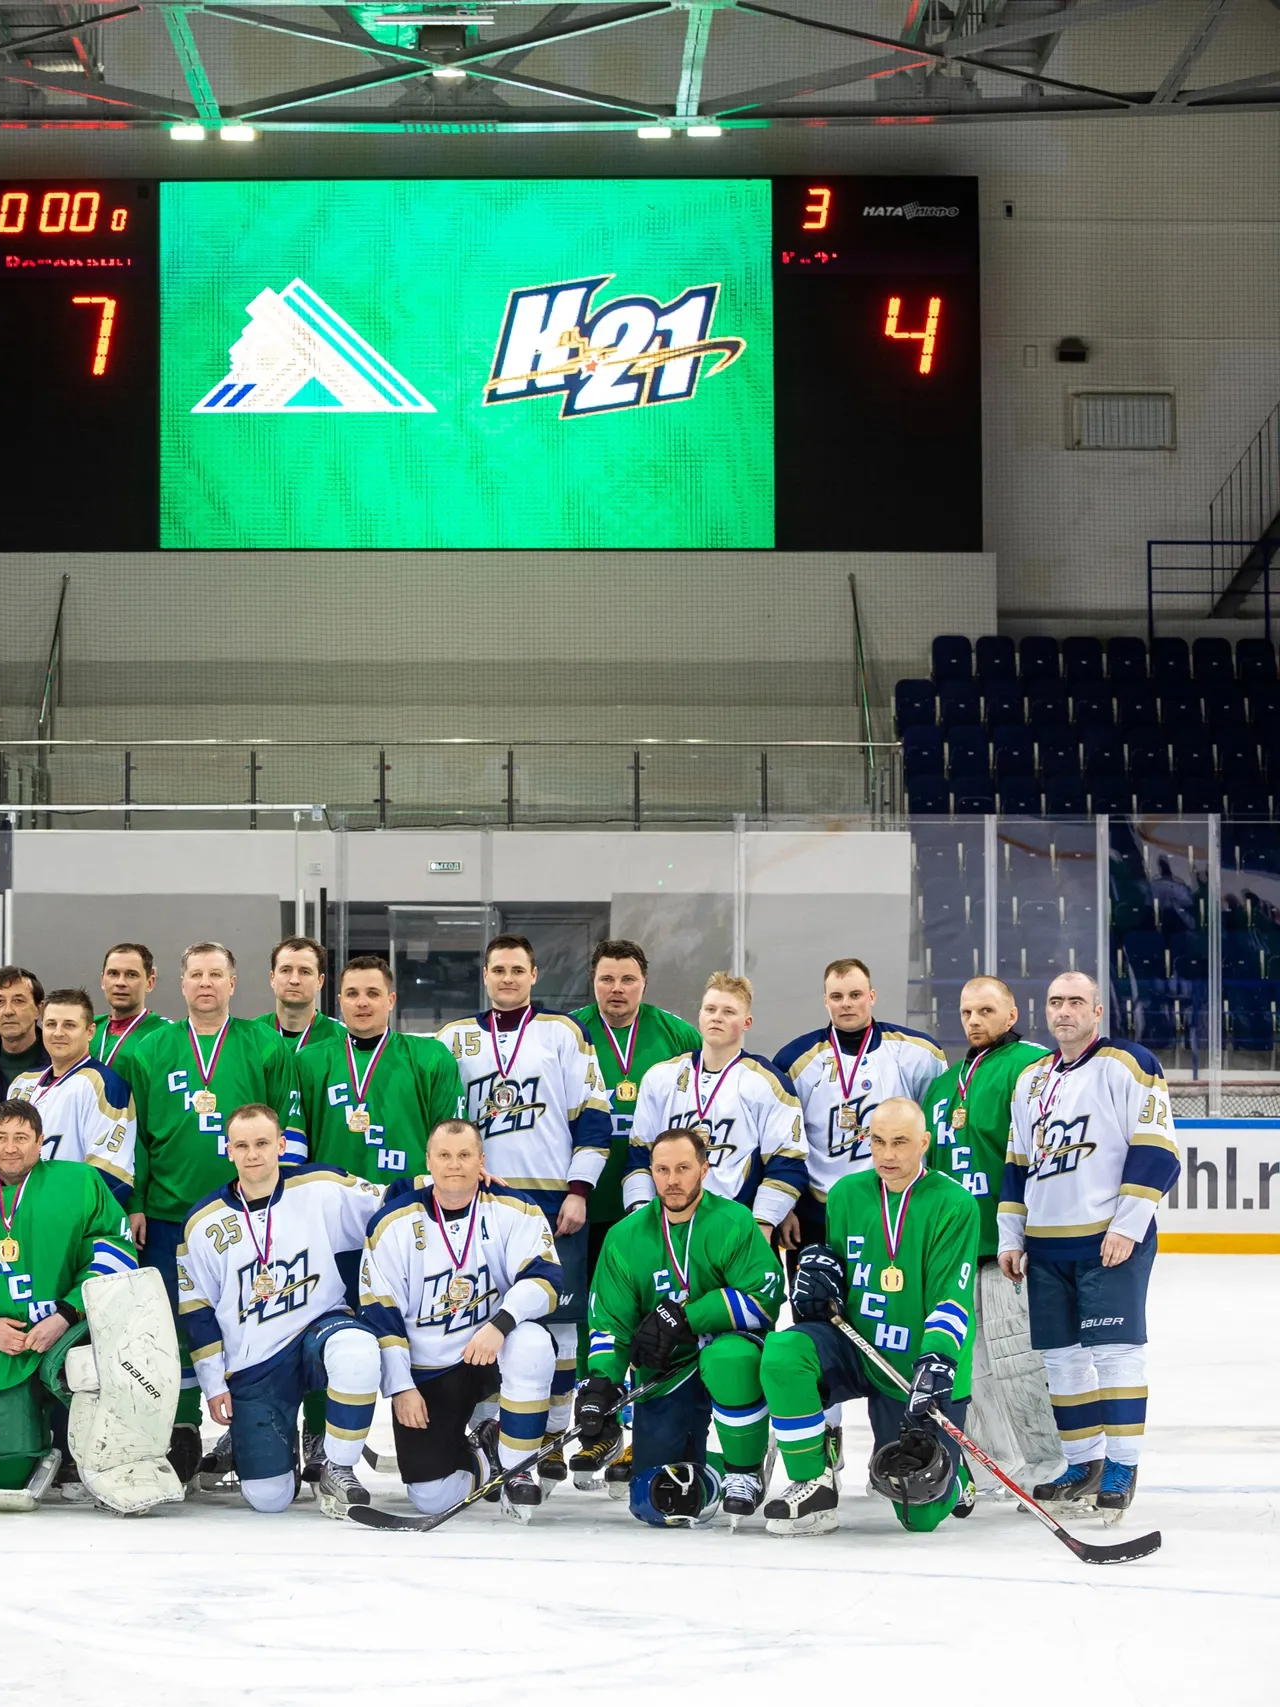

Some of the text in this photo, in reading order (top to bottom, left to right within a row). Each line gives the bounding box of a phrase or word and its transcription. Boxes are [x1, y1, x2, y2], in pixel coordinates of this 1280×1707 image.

[803, 188, 831, 229] 3
[72, 296, 116, 375] 7
[884, 296, 941, 375] 4
[431, 862, 459, 871] ЫХОД
[451, 1031, 481, 1060] 45
[676, 1066, 691, 1093] 4
[1138, 1094, 1168, 1128] 92
[791, 1115, 801, 1143] 4
[205, 1214, 242, 1254] 25
[412, 1220, 426, 1251] 5
[480, 1215, 490, 1241] A
[958, 1261, 971, 1290] 9
[846, 1236, 910, 1353] СКСЮ
[1080, 1317, 1125, 1330] BAUER
[121, 1360, 162, 1400] BAUER
